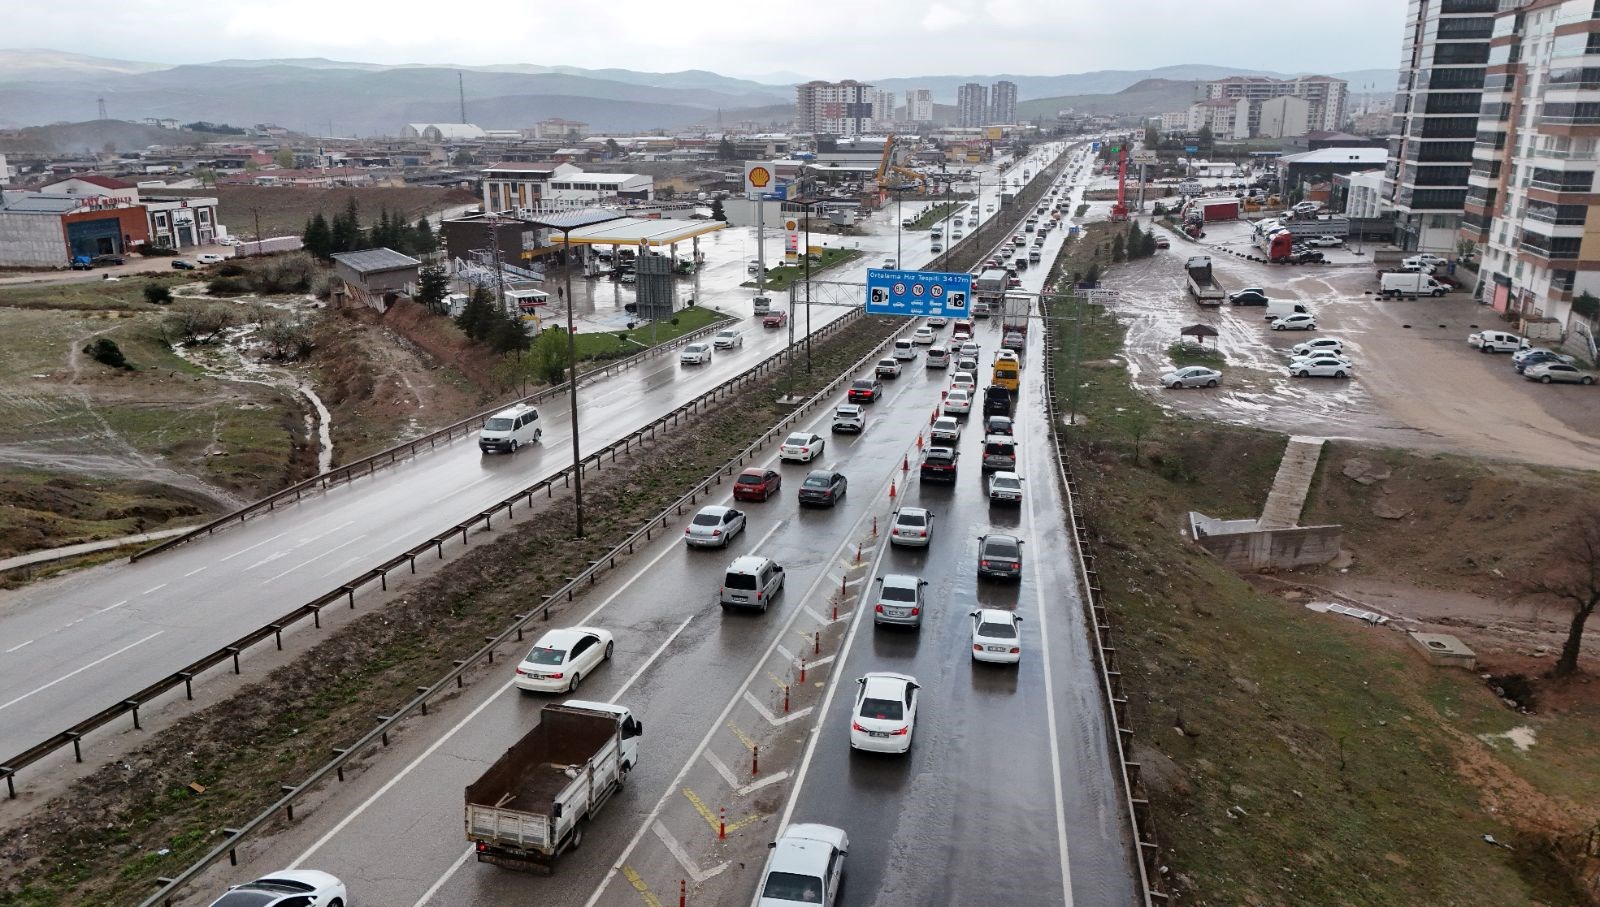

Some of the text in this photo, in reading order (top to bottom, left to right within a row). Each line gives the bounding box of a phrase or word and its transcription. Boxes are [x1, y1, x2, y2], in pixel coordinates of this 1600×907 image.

[918, 274, 940, 282] Tespiti
[943, 275, 969, 283] 3417m
[915, 286, 922, 294] 70
[933, 287, 941, 295] 70
